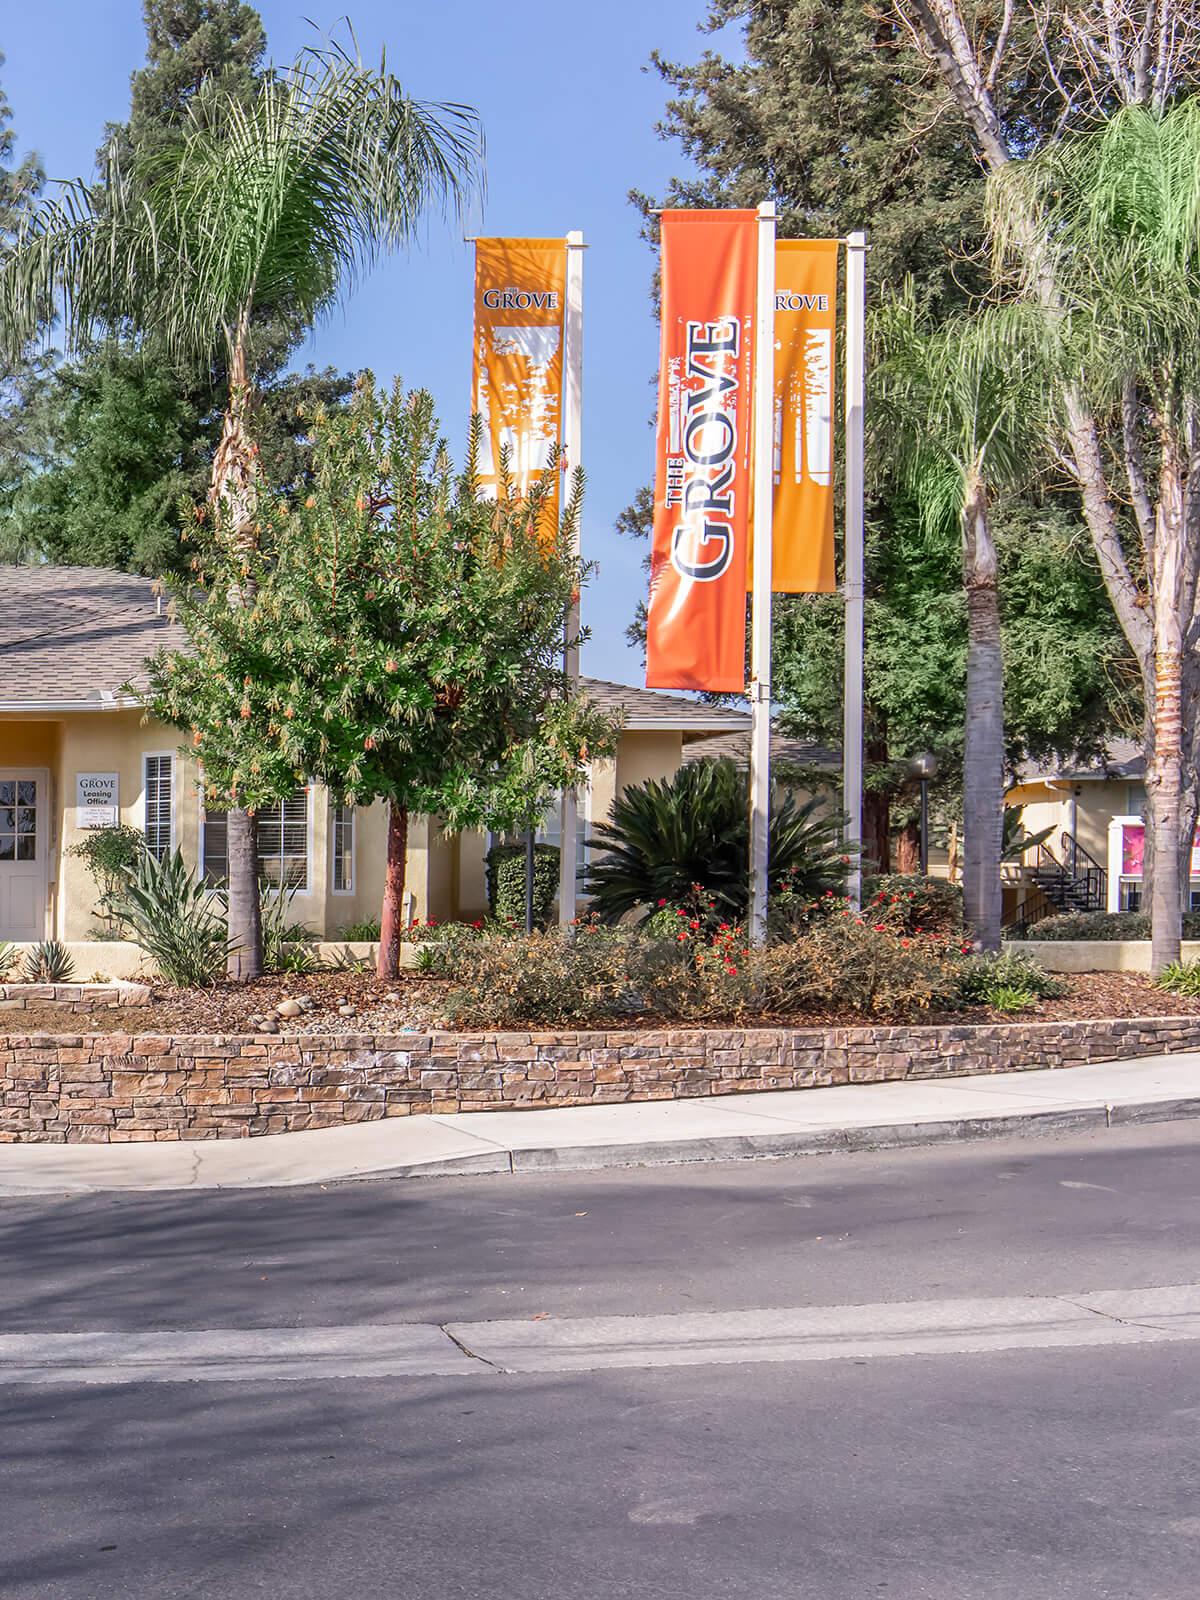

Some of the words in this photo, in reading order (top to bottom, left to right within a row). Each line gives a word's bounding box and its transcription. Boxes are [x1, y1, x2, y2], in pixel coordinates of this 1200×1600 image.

[483, 289, 559, 309] GROVE
[774, 294, 828, 311] ROVE
[672, 319, 739, 581] GROVE
[666, 457, 684, 508] THE
[79, 779, 116, 789] GROVE
[83, 790, 112, 799] Leasing
